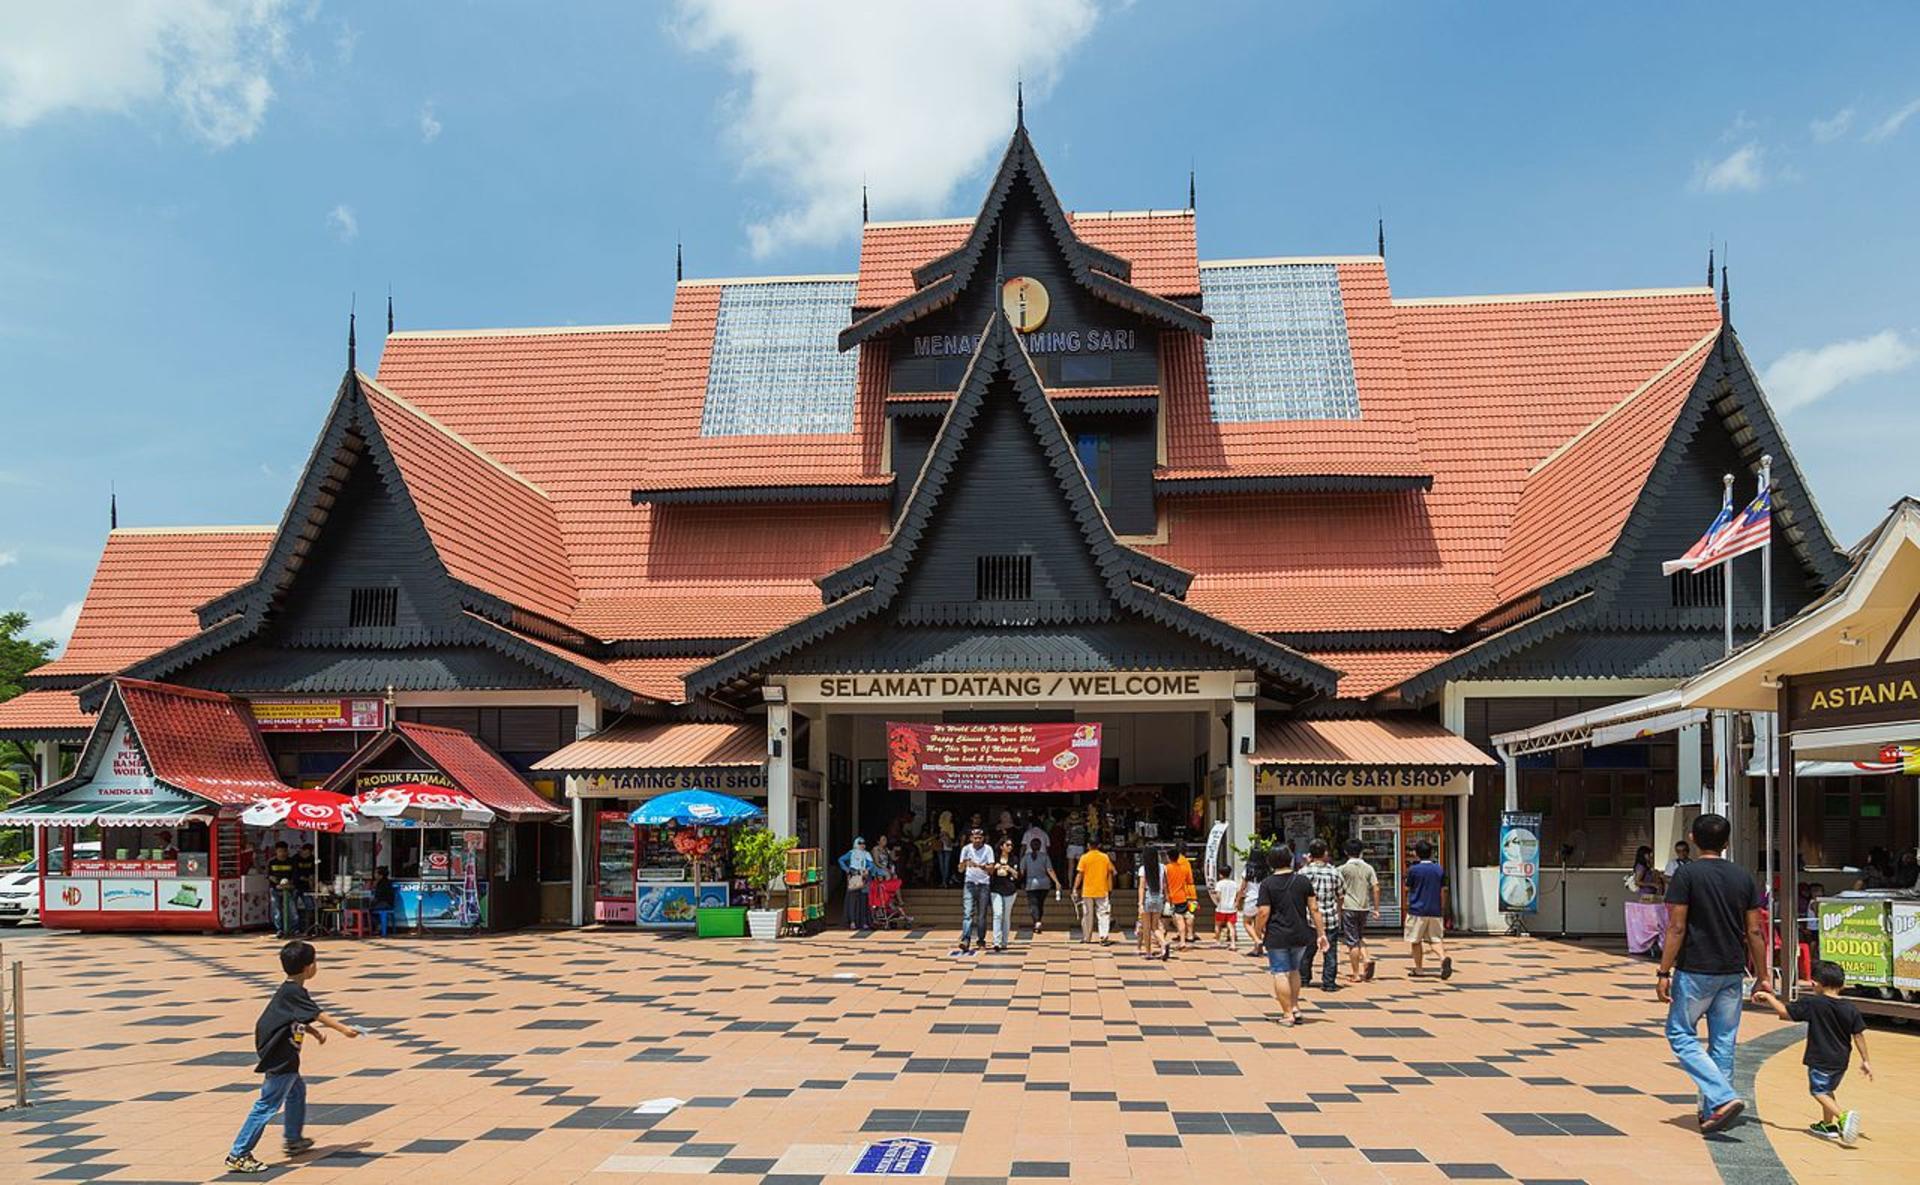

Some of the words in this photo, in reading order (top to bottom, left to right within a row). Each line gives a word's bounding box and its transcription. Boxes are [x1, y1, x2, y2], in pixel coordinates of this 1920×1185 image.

[1019, 331, 1081, 353] AMING
[1086, 329, 1135, 351] SARI
[820, 678, 936, 696] SELAMAT
[941, 677, 1041, 696] DATANG
[1068, 674, 1200, 695] WELCOME
[1810, 680, 1919, 711] ASTANA
[1019, 725, 1033, 734] You
[956, 734, 982, 743] Chinese
[356, 773, 403, 788] PRODUK
[611, 776, 676, 789] TAMING
[681, 776, 720, 789] SARI
[1276, 773, 1347, 787] TAMING
[1352, 773, 1396, 787] SARI
[1401, 773, 1452, 787] SHOP
[1826, 939, 1881, 957] DODOL
